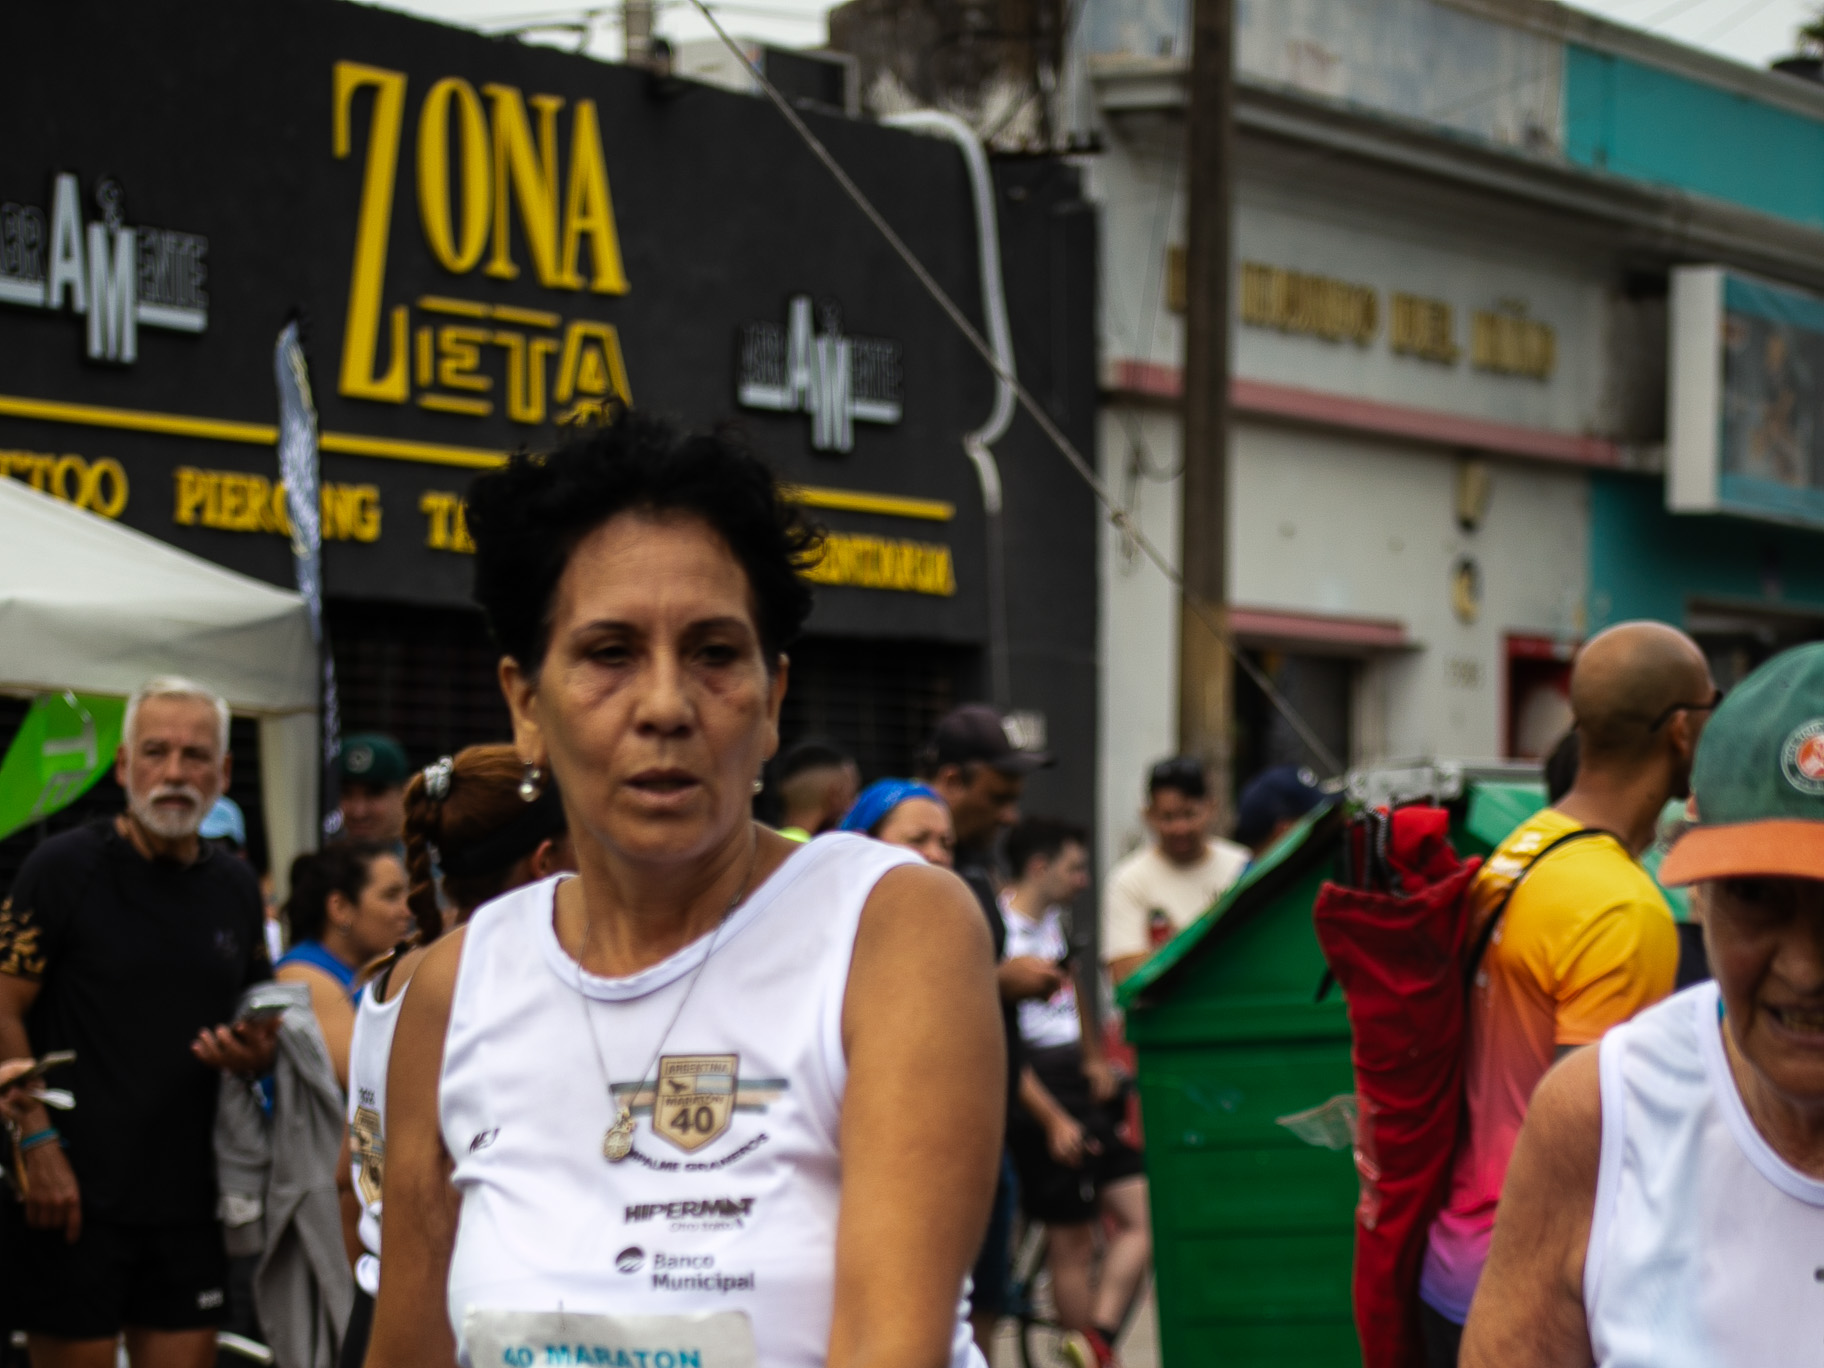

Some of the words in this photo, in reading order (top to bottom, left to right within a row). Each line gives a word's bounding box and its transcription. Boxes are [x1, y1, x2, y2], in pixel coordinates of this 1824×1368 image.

[173, 464, 382, 543] PIERCNG
[670, 1105, 715, 1135] 40
[653, 1253, 715, 1270] Banco
[651, 1272, 755, 1294] Municipal
